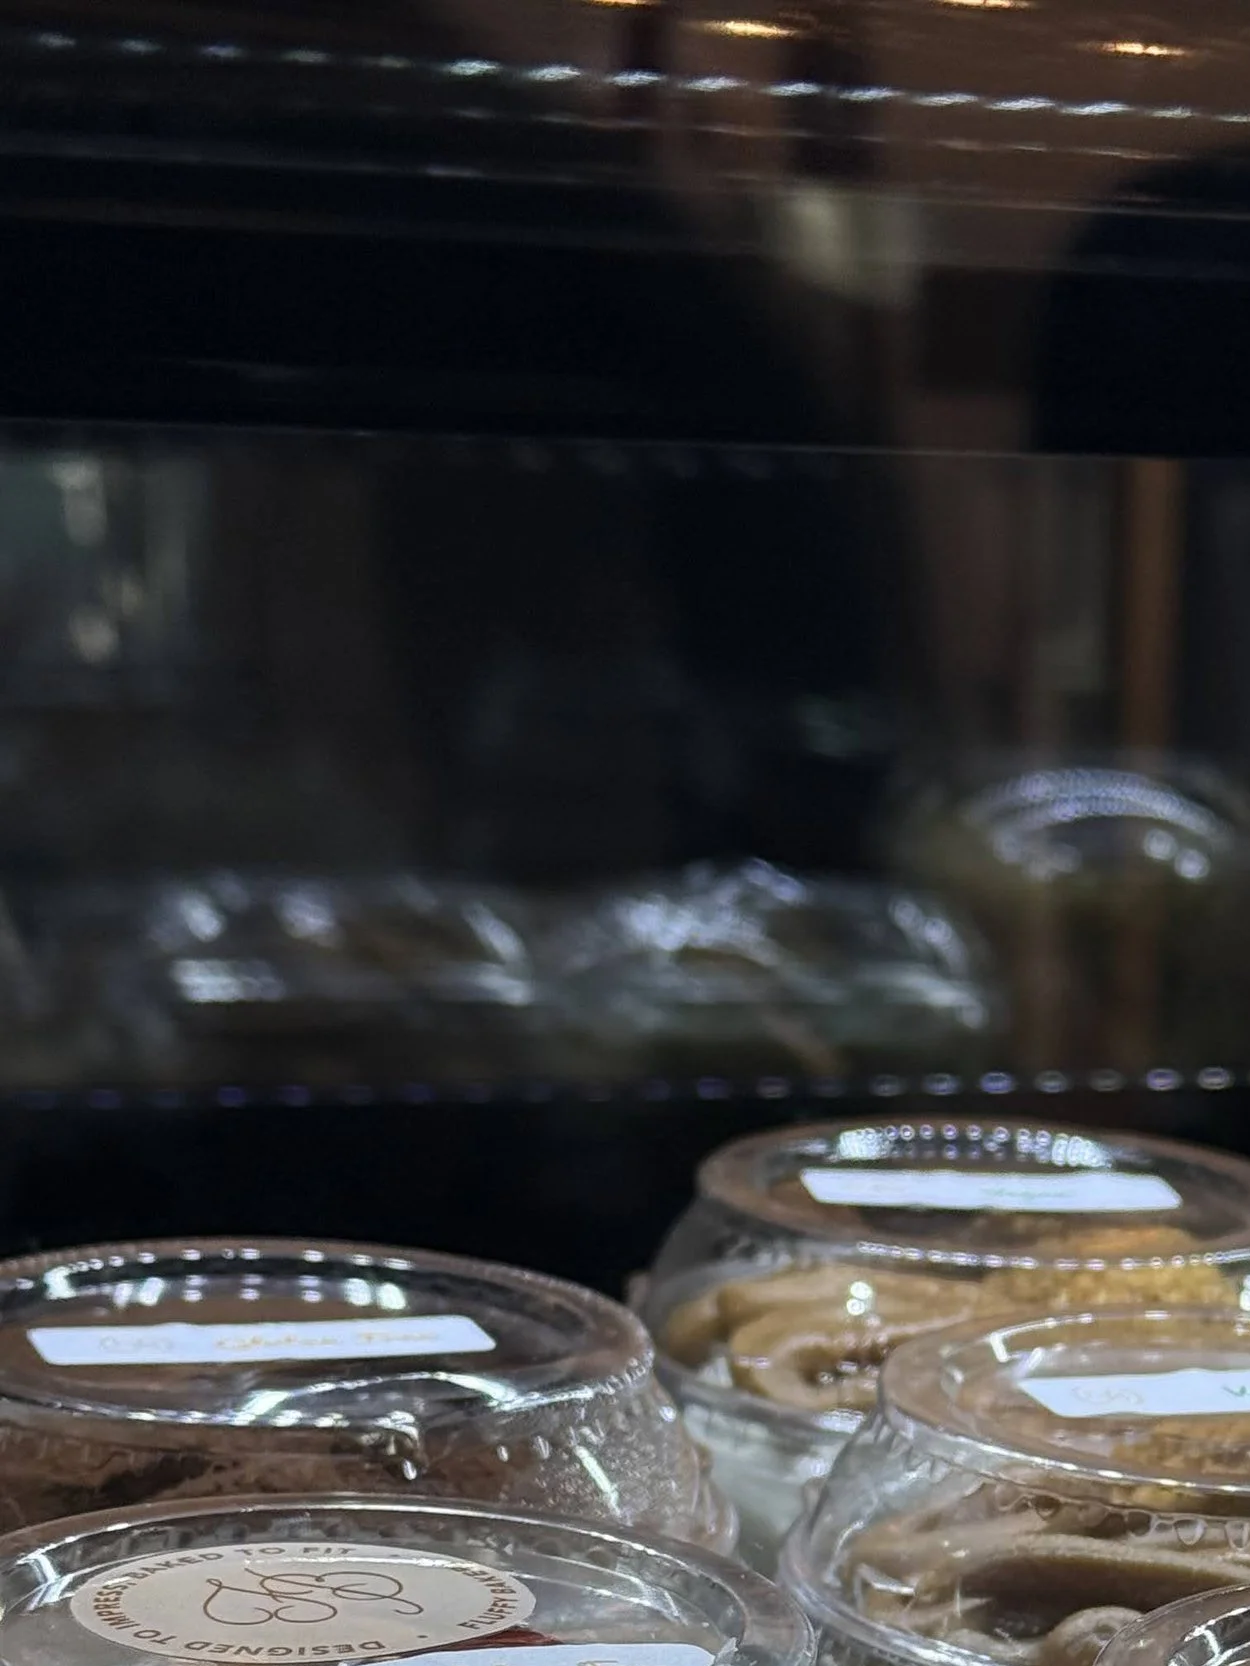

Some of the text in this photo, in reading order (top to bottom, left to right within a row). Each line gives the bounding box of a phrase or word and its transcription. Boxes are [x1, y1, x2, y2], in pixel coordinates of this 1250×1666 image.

[233, 1547, 286, 1555] TO
[303, 1546, 356, 1554] FIT
[123, 1552, 224, 1579] BAKED
[456, 1595, 519, 1630] FLUFFY
[133, 1629, 177, 1645] TO
[184, 1640, 386, 1656] DESIGNED
